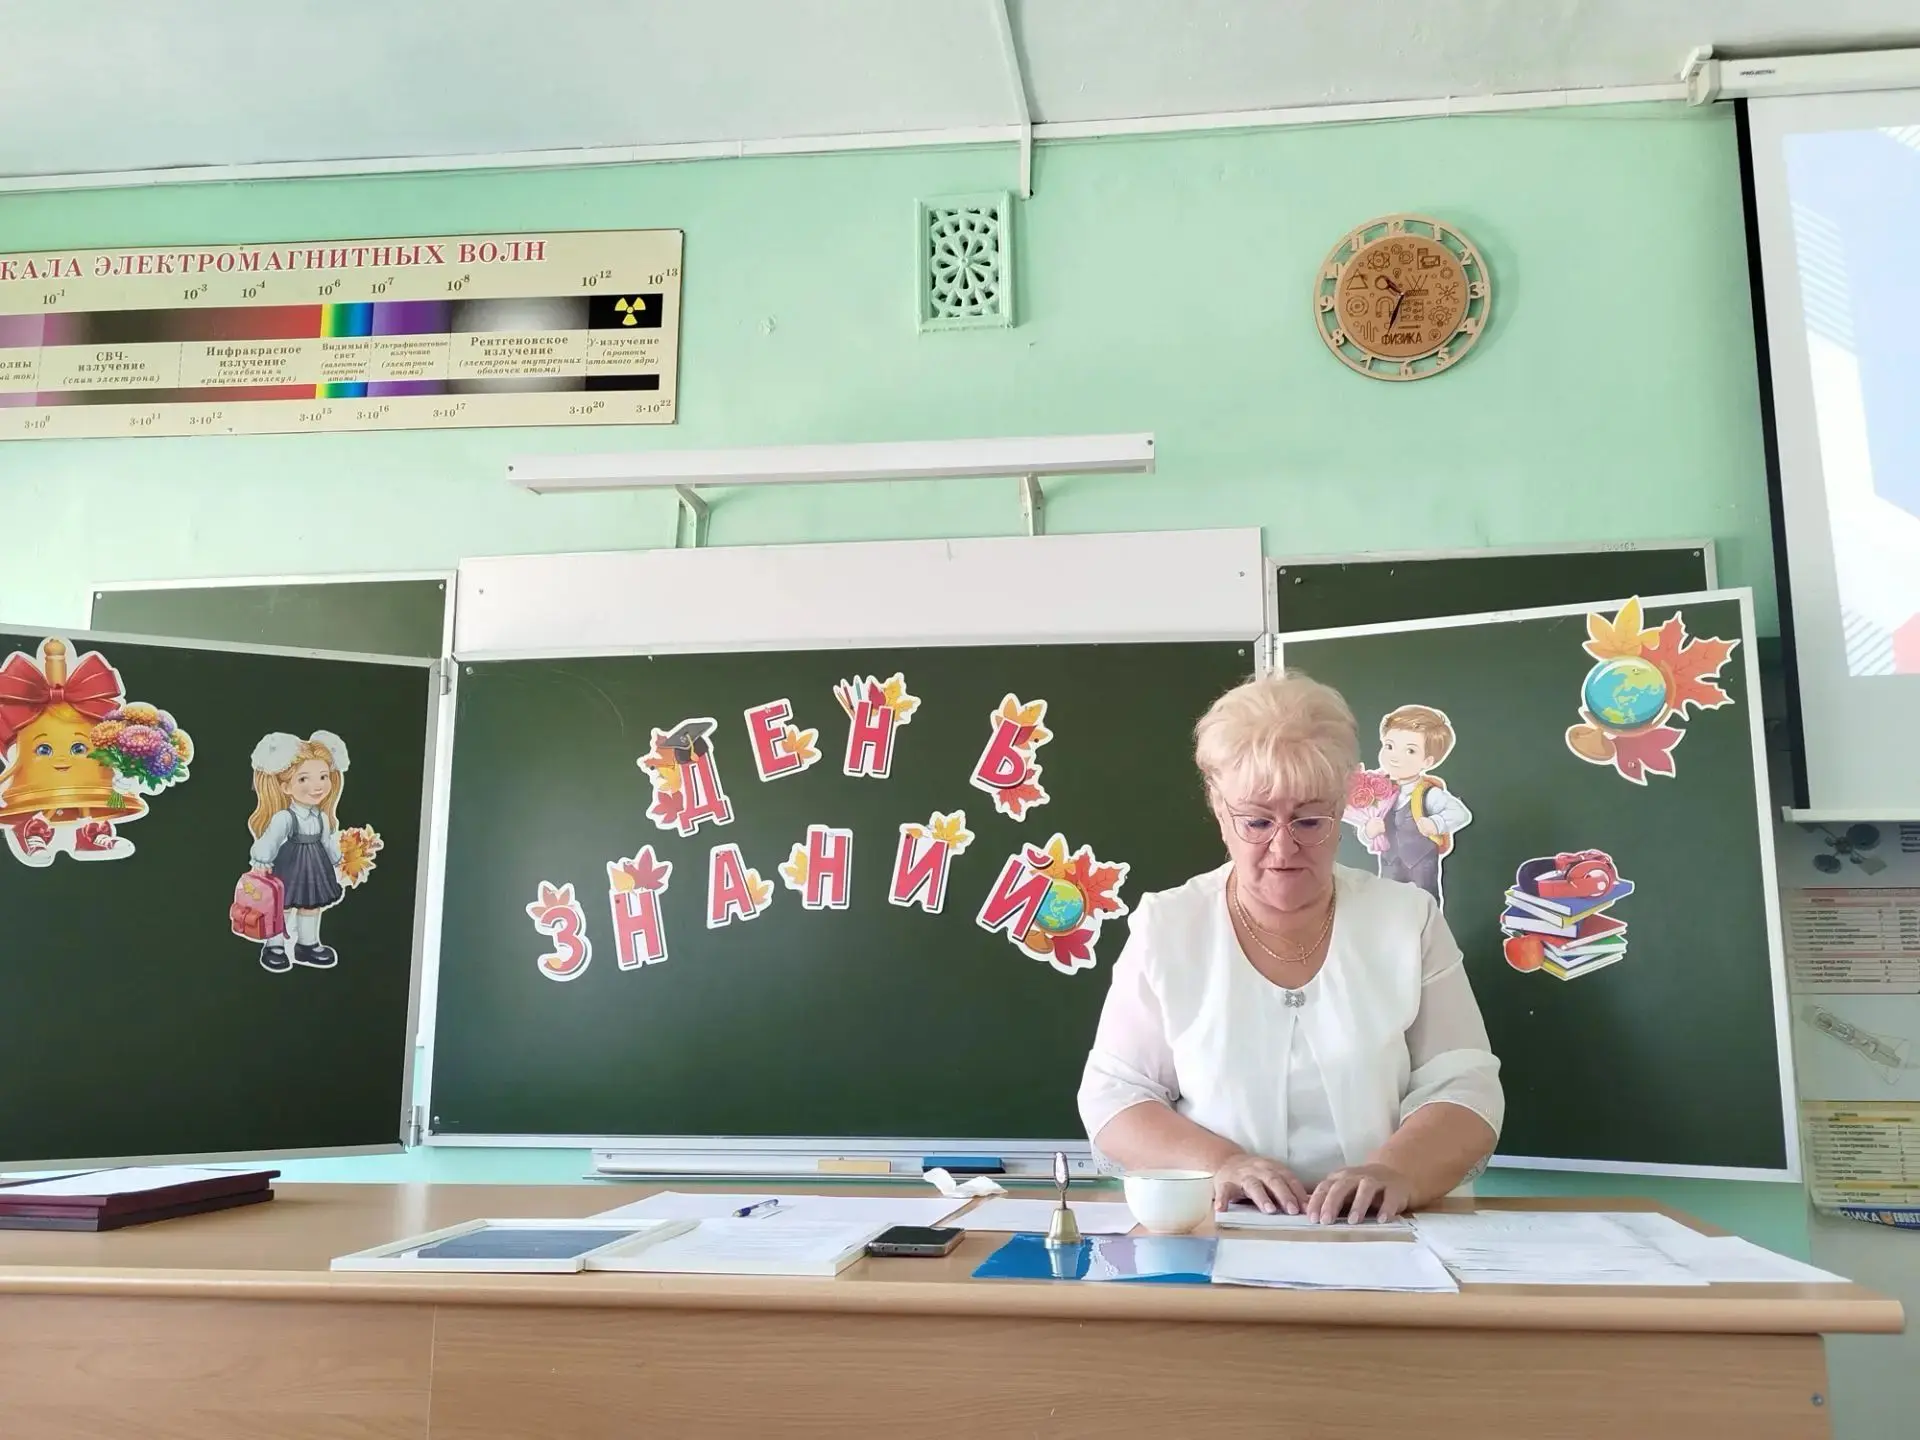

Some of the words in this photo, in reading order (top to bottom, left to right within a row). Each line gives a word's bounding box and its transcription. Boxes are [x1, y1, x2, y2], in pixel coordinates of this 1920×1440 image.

[0, 258, 83, 280] КАЛА
[95, 245, 445, 277] ЭЛЕКТРОМАГНИТНЫХ
[458, 241, 546, 263] ВОЛН
[471, 336, 569, 346] Рентгеновское
[1331, 329, 1344, 347] 8
[1381, 332, 1422, 345] ФИЗИКА
[206, 346, 302, 357] Инфракрасное
[322, 342, 369, 351] Видимый
[96, 351, 128, 361] СВЧ-
[484, 348, 553, 358] излучение
[78, 362, 145, 373] излучение
[219, 358, 287, 369] излучение
[459, 360, 517, 368] (электроны
[523, 366, 561, 374] атома)
[97, 374, 160, 385] электрона)
[677, 701, 1030, 833] ДЕНЬ
[538, 829, 1054, 975] ЗНАНИЙ
